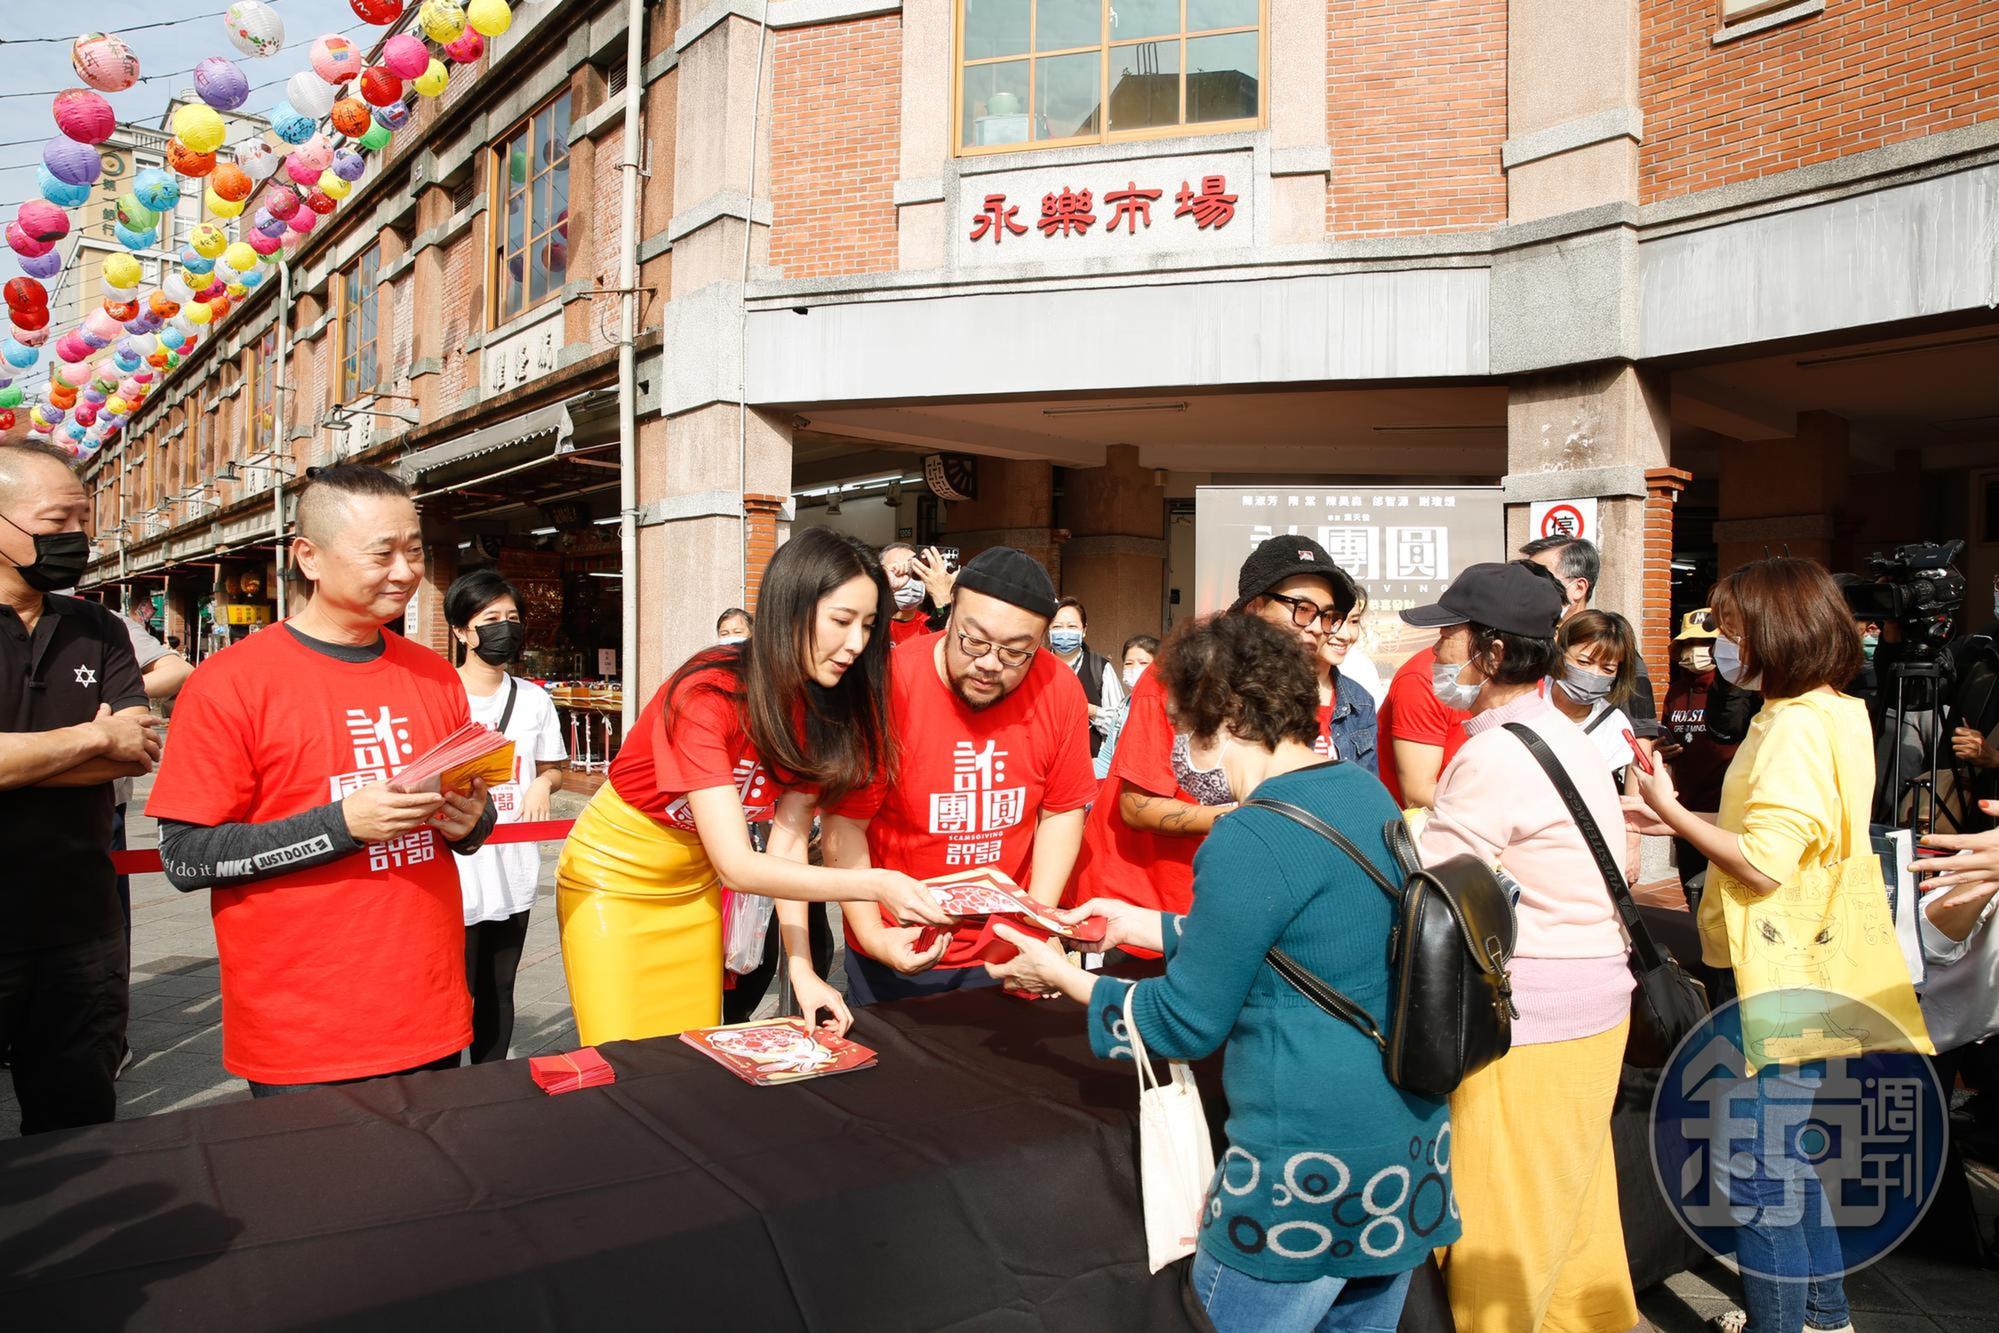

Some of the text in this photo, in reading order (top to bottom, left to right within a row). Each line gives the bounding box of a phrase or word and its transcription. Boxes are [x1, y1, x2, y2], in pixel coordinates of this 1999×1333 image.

[969, 174, 1239, 245] 永樂市場
[1251, 525, 1448, 580] 團圓
[346, 706, 412, 768] 詐
[953, 740, 1008, 791] 詐
[929, 787, 1026, 834] 團圓
[947, 840, 1002, 854] 2023
[948, 831, 1004, 841] SCAMSGIVING
[215, 857, 254, 878] NIKE
[259, 851, 285, 868] JUST
[284, 846, 302, 861] DO
[370, 846, 434, 872] 0120
[945, 851, 1000, 865] 0120
[176, 862, 198, 877] do
